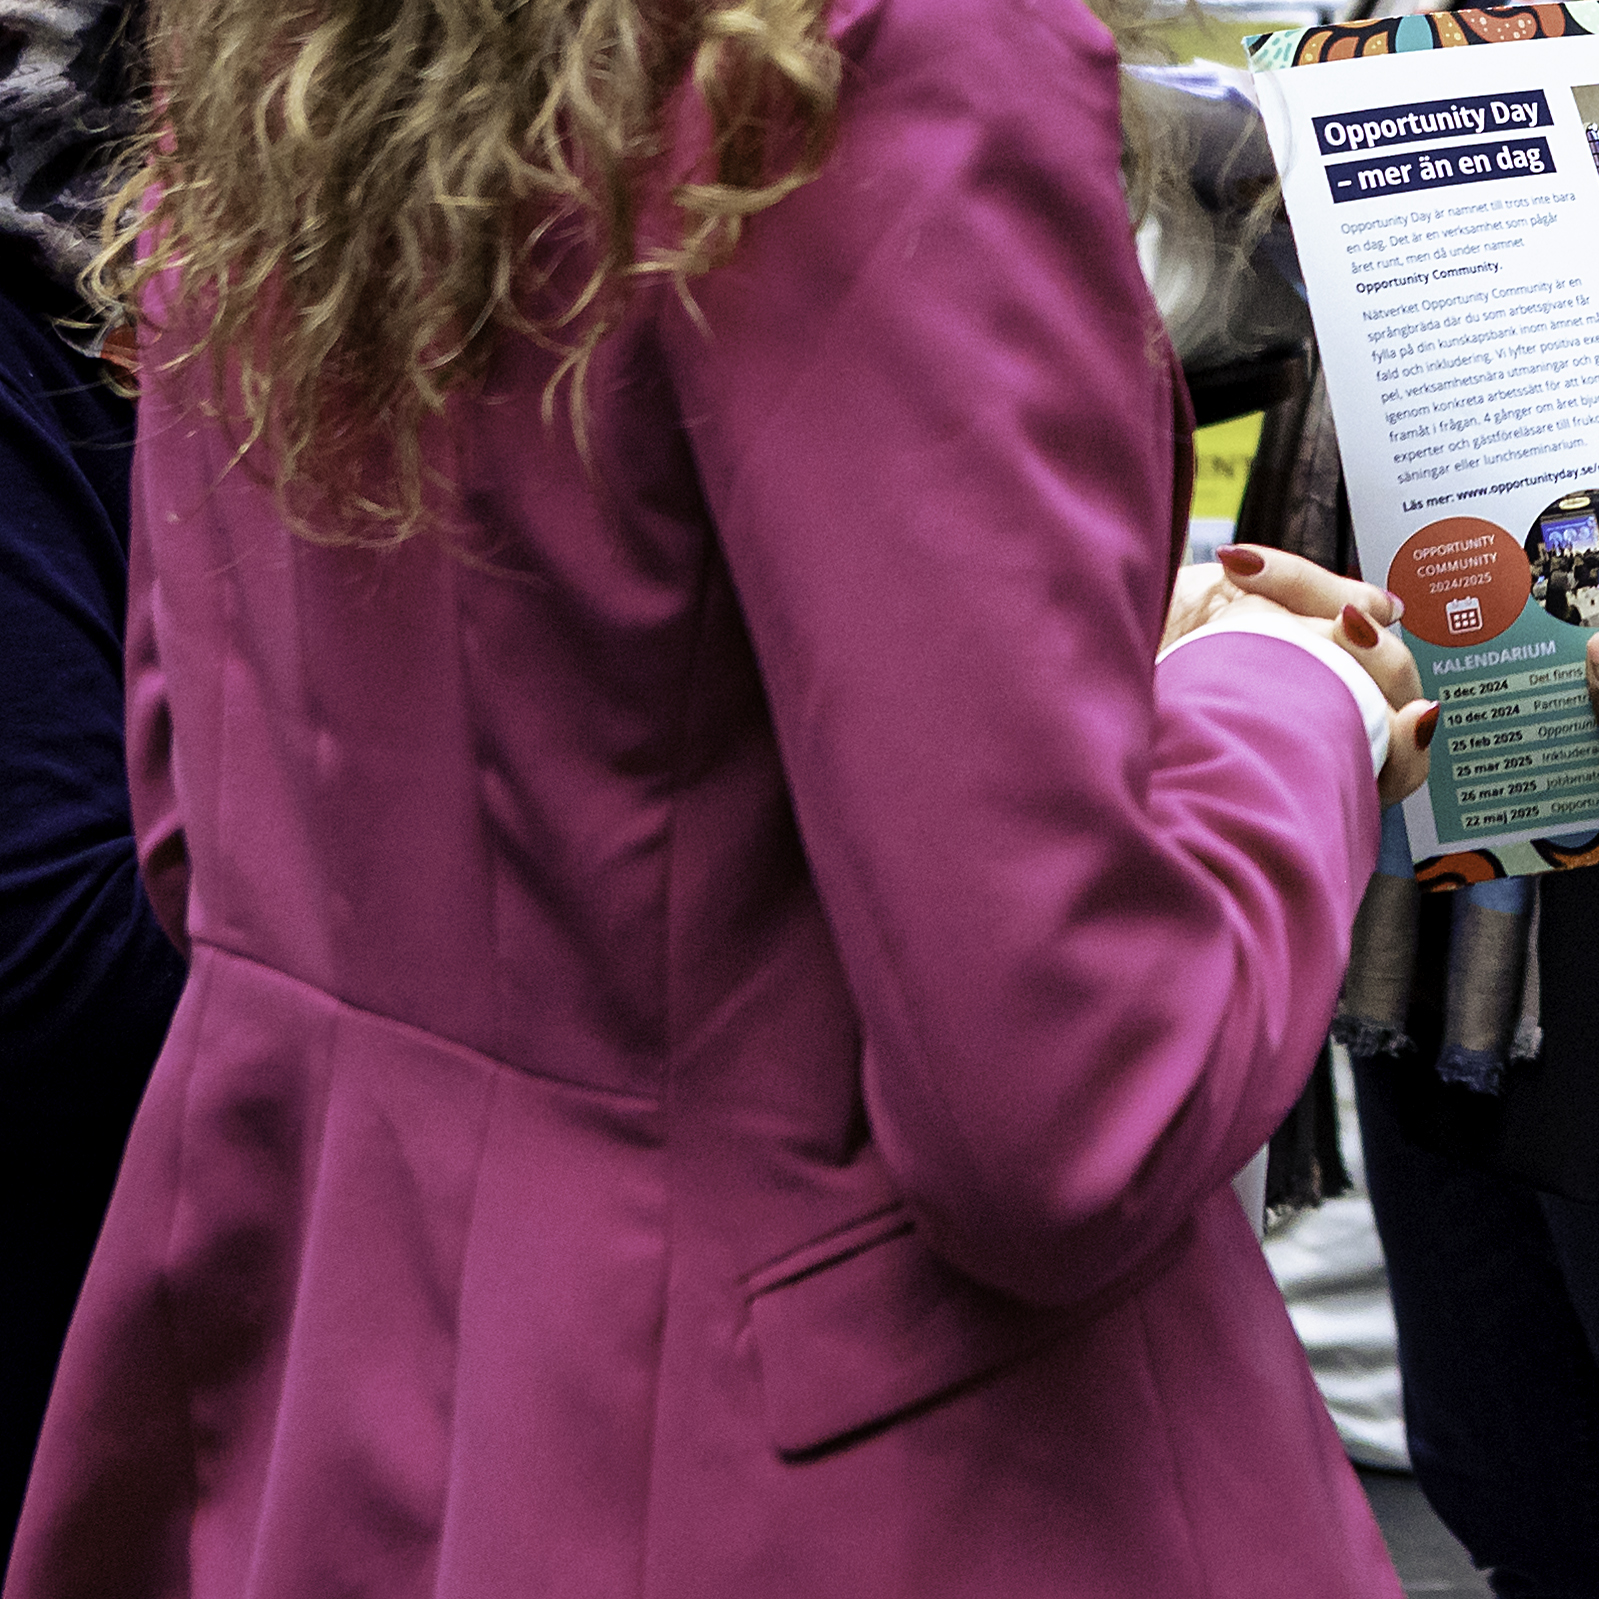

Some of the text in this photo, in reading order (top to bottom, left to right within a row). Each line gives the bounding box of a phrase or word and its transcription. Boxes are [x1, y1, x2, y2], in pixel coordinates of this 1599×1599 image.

[1324, 101, 1538, 150] Opportunity Day
[1357, 163, 1411, 189] mer
[1418, 155, 1453, 180] än
[1458, 154, 1491, 174] en
[1496, 145, 1544, 172] dag
[1340, 192, 1576, 235] Opportunity Day är namnet till trots inte bara
[1345, 211, 1557, 254] en dag. Det är en verksamhet som pågår
[1351, 237, 1524, 274] året runt, men då under namnet
[1355, 262, 1502, 294] Opportunity Community.
[1362, 277, 1581, 321] Nätverket Opportunity Community är en
[1367, 294, 1589, 343] språngbräda där du som arbetsgivare får
[1370, 348, 1396, 364] fylla
[1398, 342, 1414, 359] på
[1416, 341, 1435, 353] din
[1437, 326, 1515, 348] kunskapsbank
[1519, 323, 1547, 333] inom
[1550, 316, 1583, 330] ämnet
[1375, 367, 1399, 382] fald
[1401, 363, 1424, 377] och
[1425, 352, 1494, 372] inkludering.
[1494, 347, 1506, 358] Vi
[1508, 344, 1536, 359] lyfter
[1539, 337, 1580, 354] positiva
[1380, 388, 1403, 405] pel,
[1404, 370, 1504, 397] verksamhetsnära
[1506, 359, 1568, 377] utmaningar
[1572, 355, 1591, 367] och
[1384, 405, 1430, 425] igenom
[1431, 394, 1484, 412] konkreta
[1487, 383, 1543, 402] arbetssätt
[1544, 380, 1560, 390] för
[1564, 377, 1578, 388] att
[1388, 424, 1430, 442] framåt
[1438, 416, 1480, 432] frågan.
[1483, 412, 1491, 422] 4
[1493, 406, 1532, 425] gånger
[1535, 402, 1553, 413] om
[1556, 397, 1578, 410] året
[1393, 444, 1444, 463] experter
[1447, 438, 1470, 452] och
[1472, 423, 1553, 450] gästföreläsare
[1555, 418, 1570, 430] till
[1396, 438, 1588, 484] säningar eller lunchseminarium.
[1402, 499, 1423, 512] Läs
[1425, 493, 1454, 507] mer:
[1412, 533, 1495, 560] OPPORTUNITY
[1416, 551, 1497, 577] COMMUNITY
[1429, 570, 1492, 593] 2024/2025
[1432, 638, 1556, 674] KALENDARIUM
[1442, 689, 1451, 701] 3
[1453, 686, 1476, 698] dec
[1478, 678, 1508, 694] 2024
[1447, 713, 1462, 726] 10
[1465, 711, 1487, 723] dec
[1490, 703, 1520, 719] 2024
[1451, 739, 1467, 752] 25
[1469, 735, 1490, 748] feb
[1493, 729, 1523, 745] 2025
[1455, 764, 1471, 777] 25
[1474, 761, 1500, 773] mar
[1503, 754, 1532, 769] 2025
[1460, 789, 1476, 803] 26
[1478, 787, 1504, 800] mar
[1507, 779, 1537, 795] 2025
[1465, 815, 1480, 828] 22
[1483, 810, 1507, 825] maj
[1510, 805, 1539, 820] 2025
